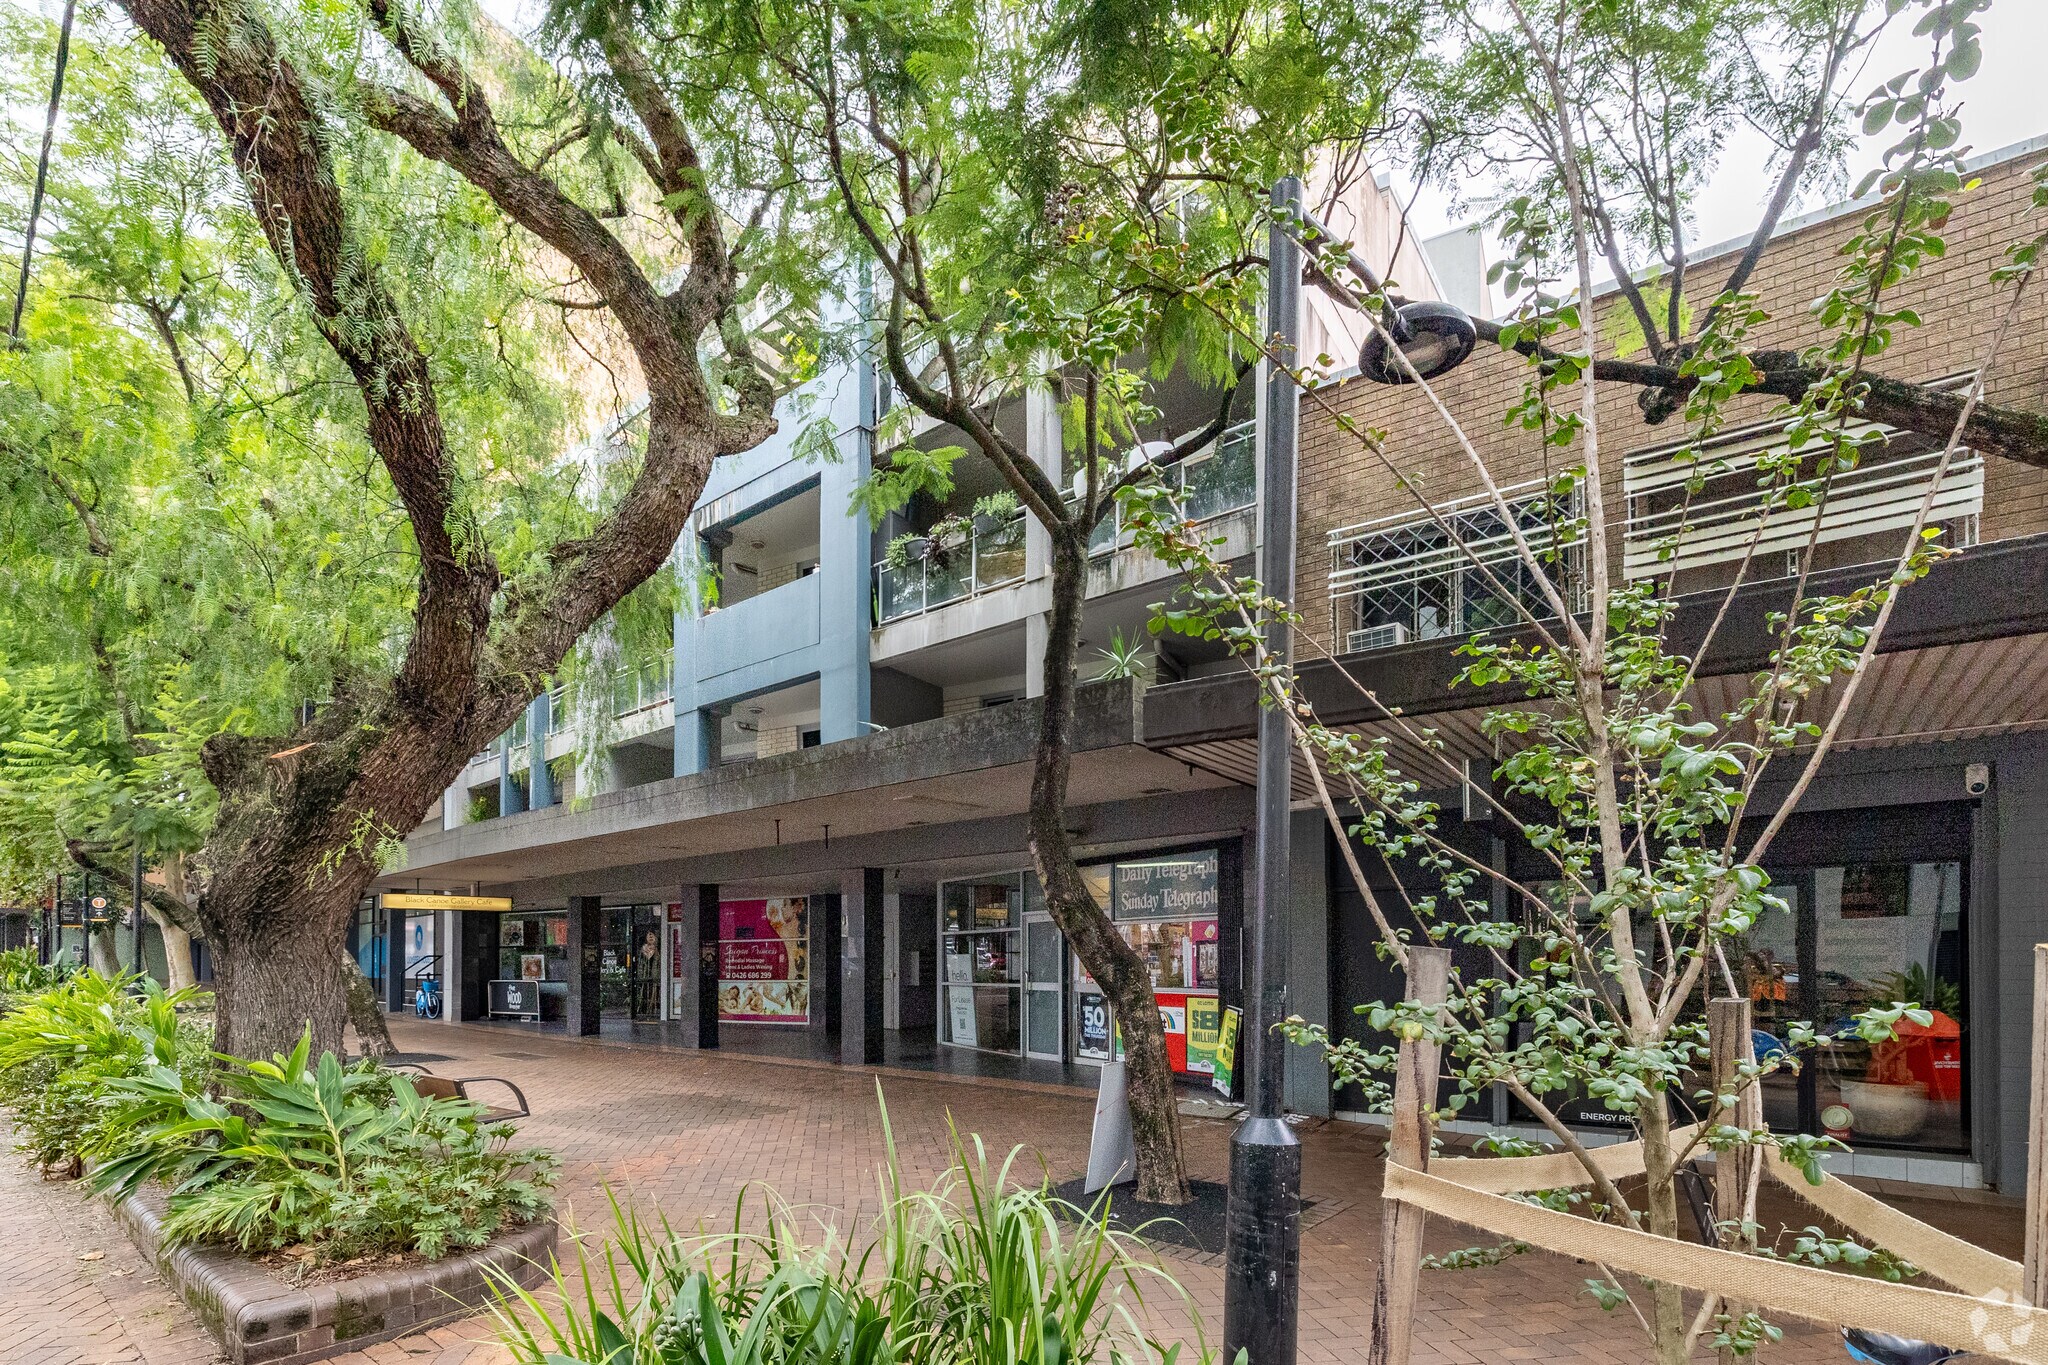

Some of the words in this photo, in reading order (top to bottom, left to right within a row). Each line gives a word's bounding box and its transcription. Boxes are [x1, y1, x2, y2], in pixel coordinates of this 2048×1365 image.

[1121, 866, 1152, 884] Daily
[1155, 856, 1218, 881] Telegraph
[405, 896, 424, 904] Black
[426, 897, 448, 905] Canoe
[450, 897, 475, 906] Gallery
[1121, 891, 1159, 912] Sunday
[1160, 885, 1218, 910] Telegraph
[1192, 1010, 1219, 1030] $8
[1580, 1112, 1617, 1122] ENERGY
